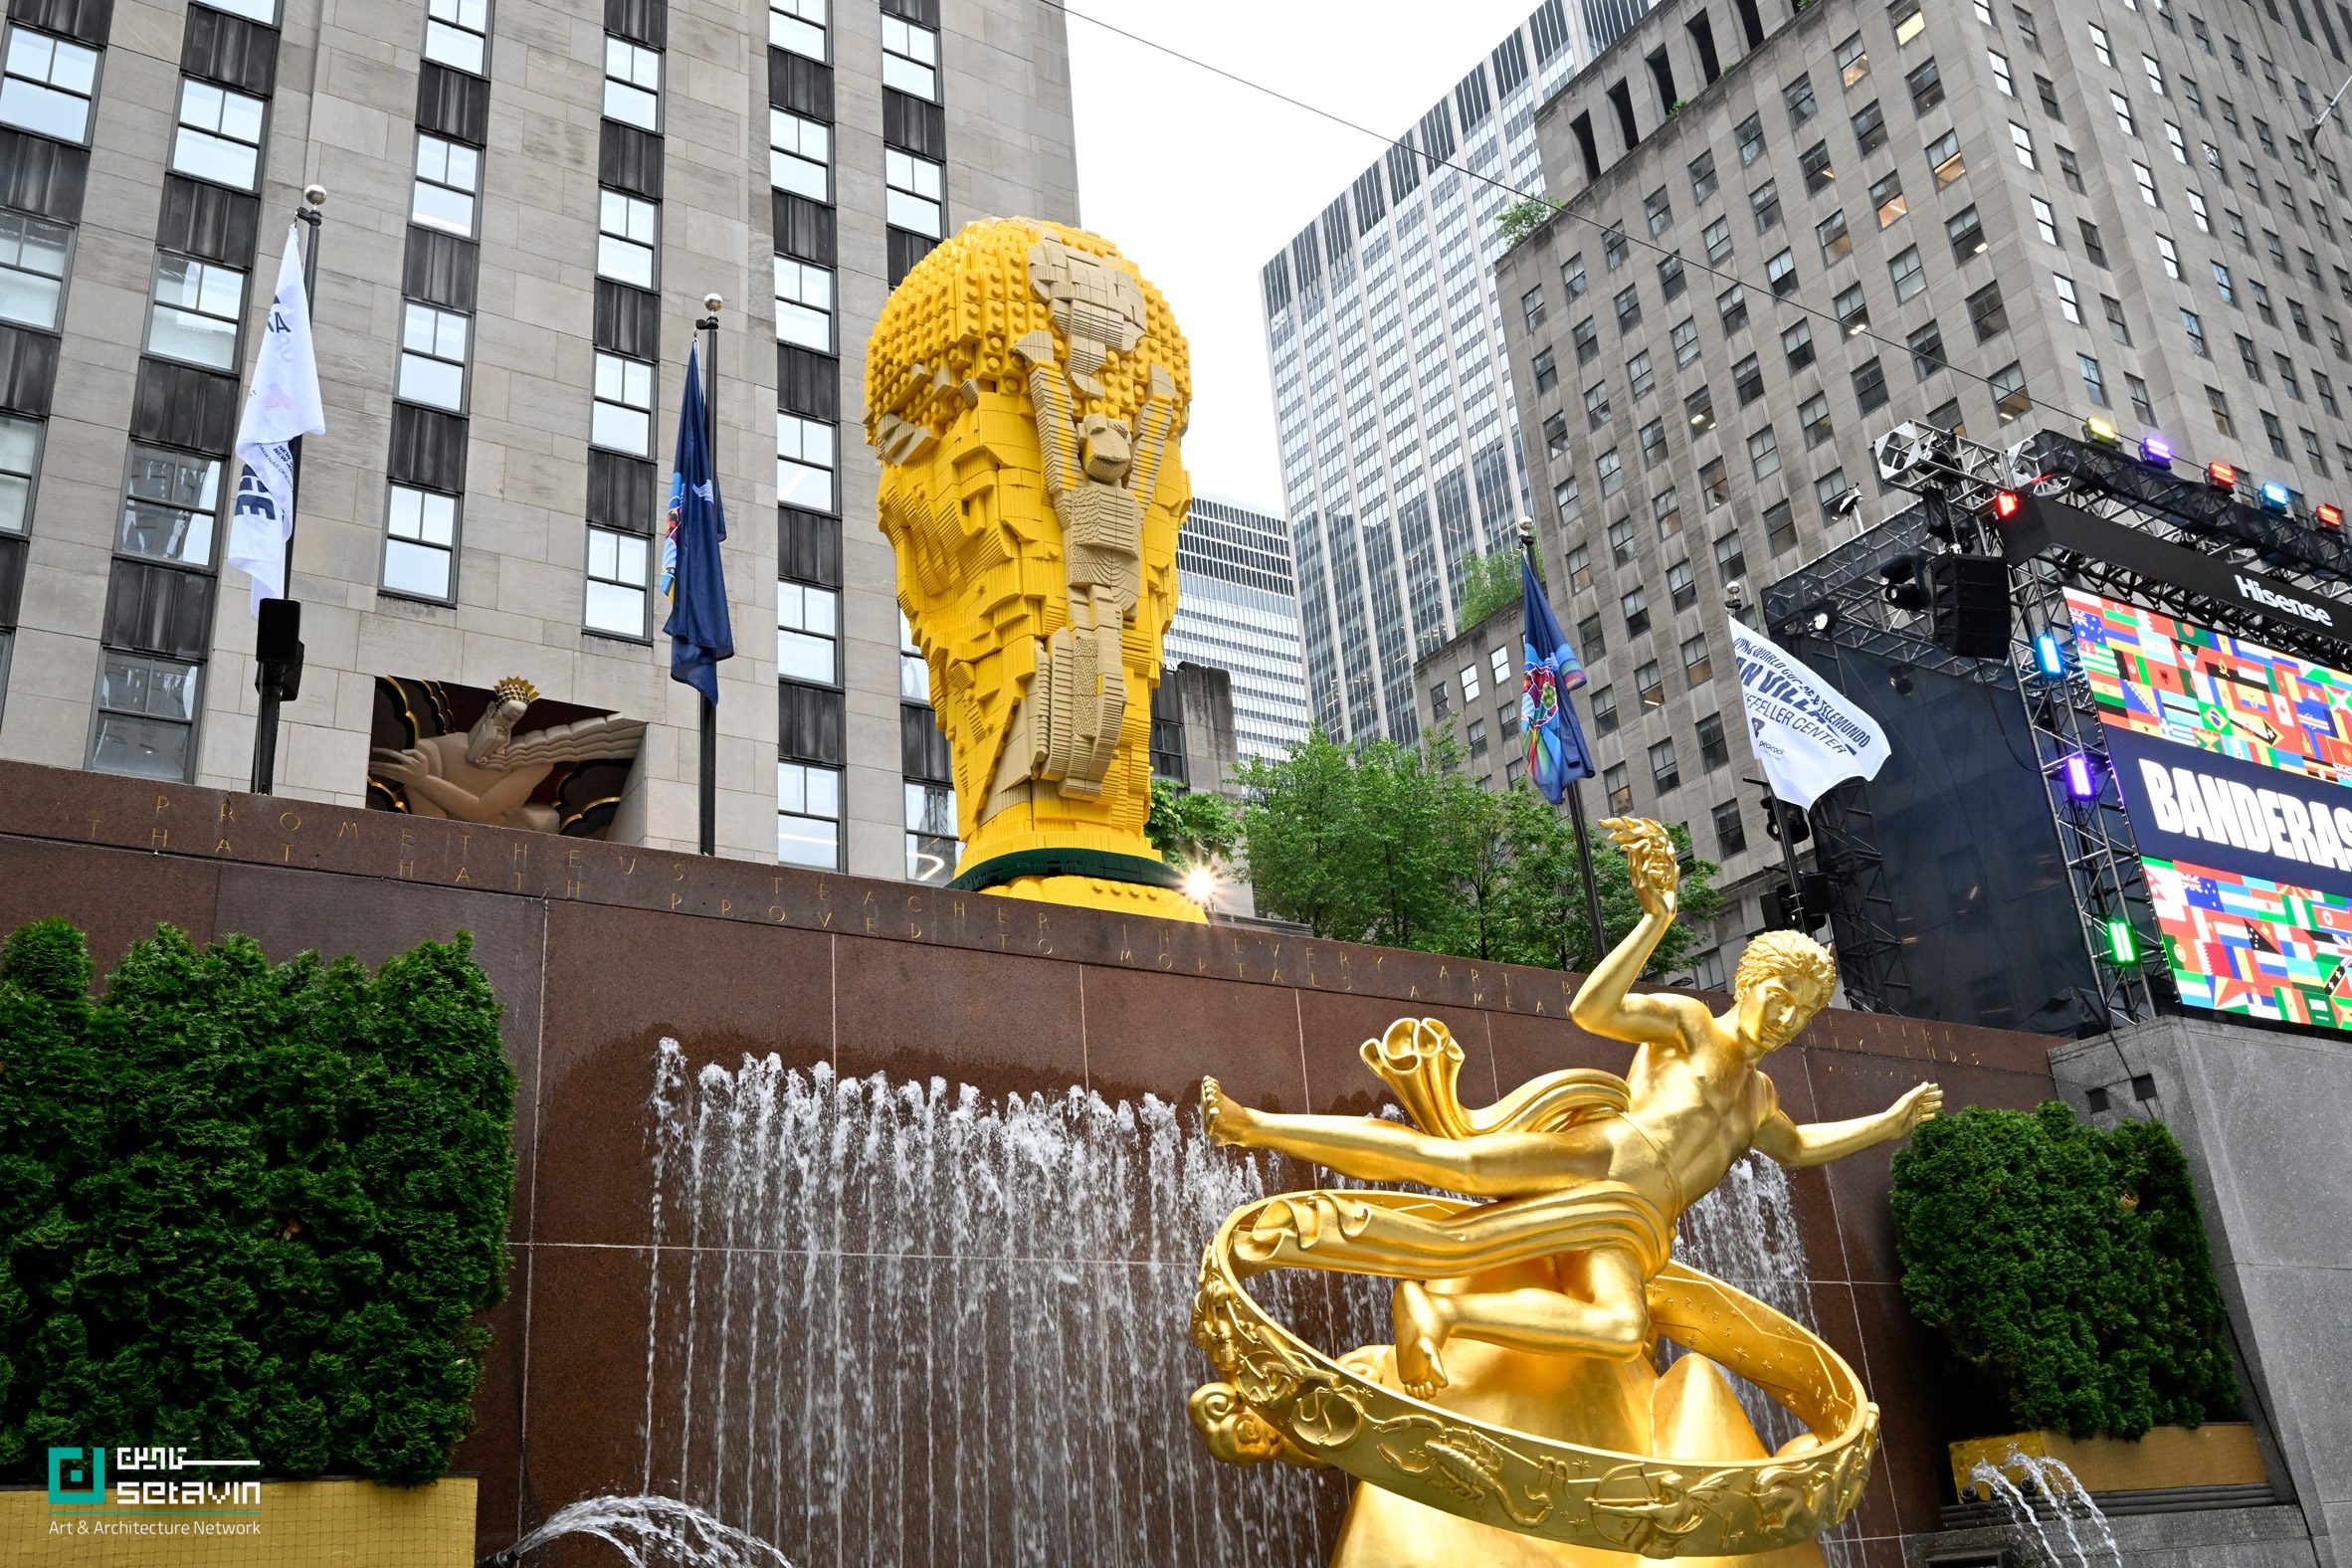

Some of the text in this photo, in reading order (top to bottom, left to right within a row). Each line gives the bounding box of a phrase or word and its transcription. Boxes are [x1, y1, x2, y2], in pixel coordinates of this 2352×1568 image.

[2235, 574, 2333, 627] Hisense
[1736, 657, 1764, 686] AN
[1753, 646, 1786, 670] WORLD
[1818, 699, 1870, 748] TELEMUNDO
[1745, 692, 1847, 753] EFELLER CENTER
[87, 818, 294, 863] THAT
[399, 859, 581, 899] HATH
[672, 892, 921, 939] PROVED
[998, 933, 1053, 955] TO
[1410, 985, 1421, 1000] A
[1473, 988, 1570, 1017] MEA
[156, 795, 685, 882] PROMETHEUS
[771, 877, 1050, 929] TEACHER
[1439, 965, 1509, 987] ART
